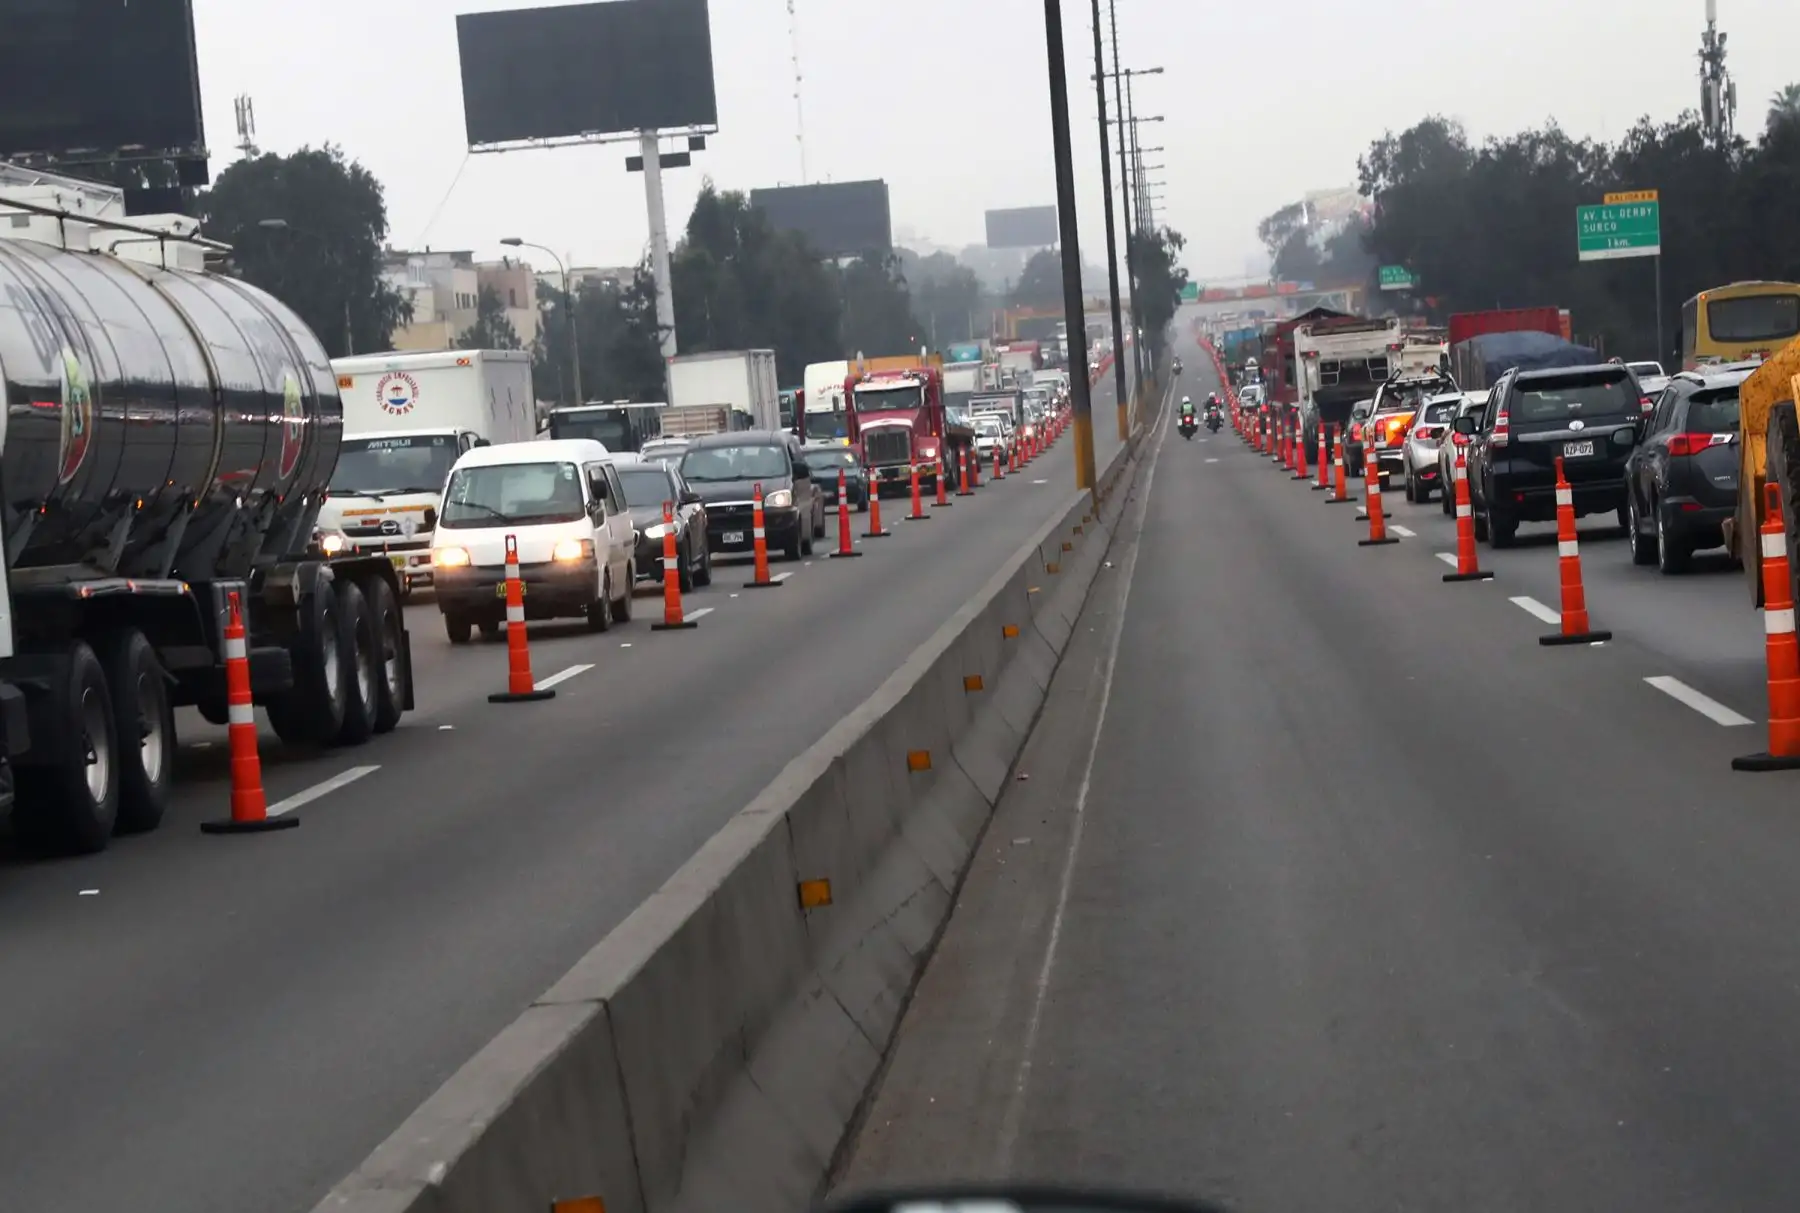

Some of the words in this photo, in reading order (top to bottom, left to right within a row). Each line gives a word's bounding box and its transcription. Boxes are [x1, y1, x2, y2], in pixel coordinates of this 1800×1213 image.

[1602, 209, 1615, 220] EL
[1619, 207, 1652, 218] DERBY
[1583, 222, 1617, 233] SURCO
[367, 438, 411, 450] MITSUI
